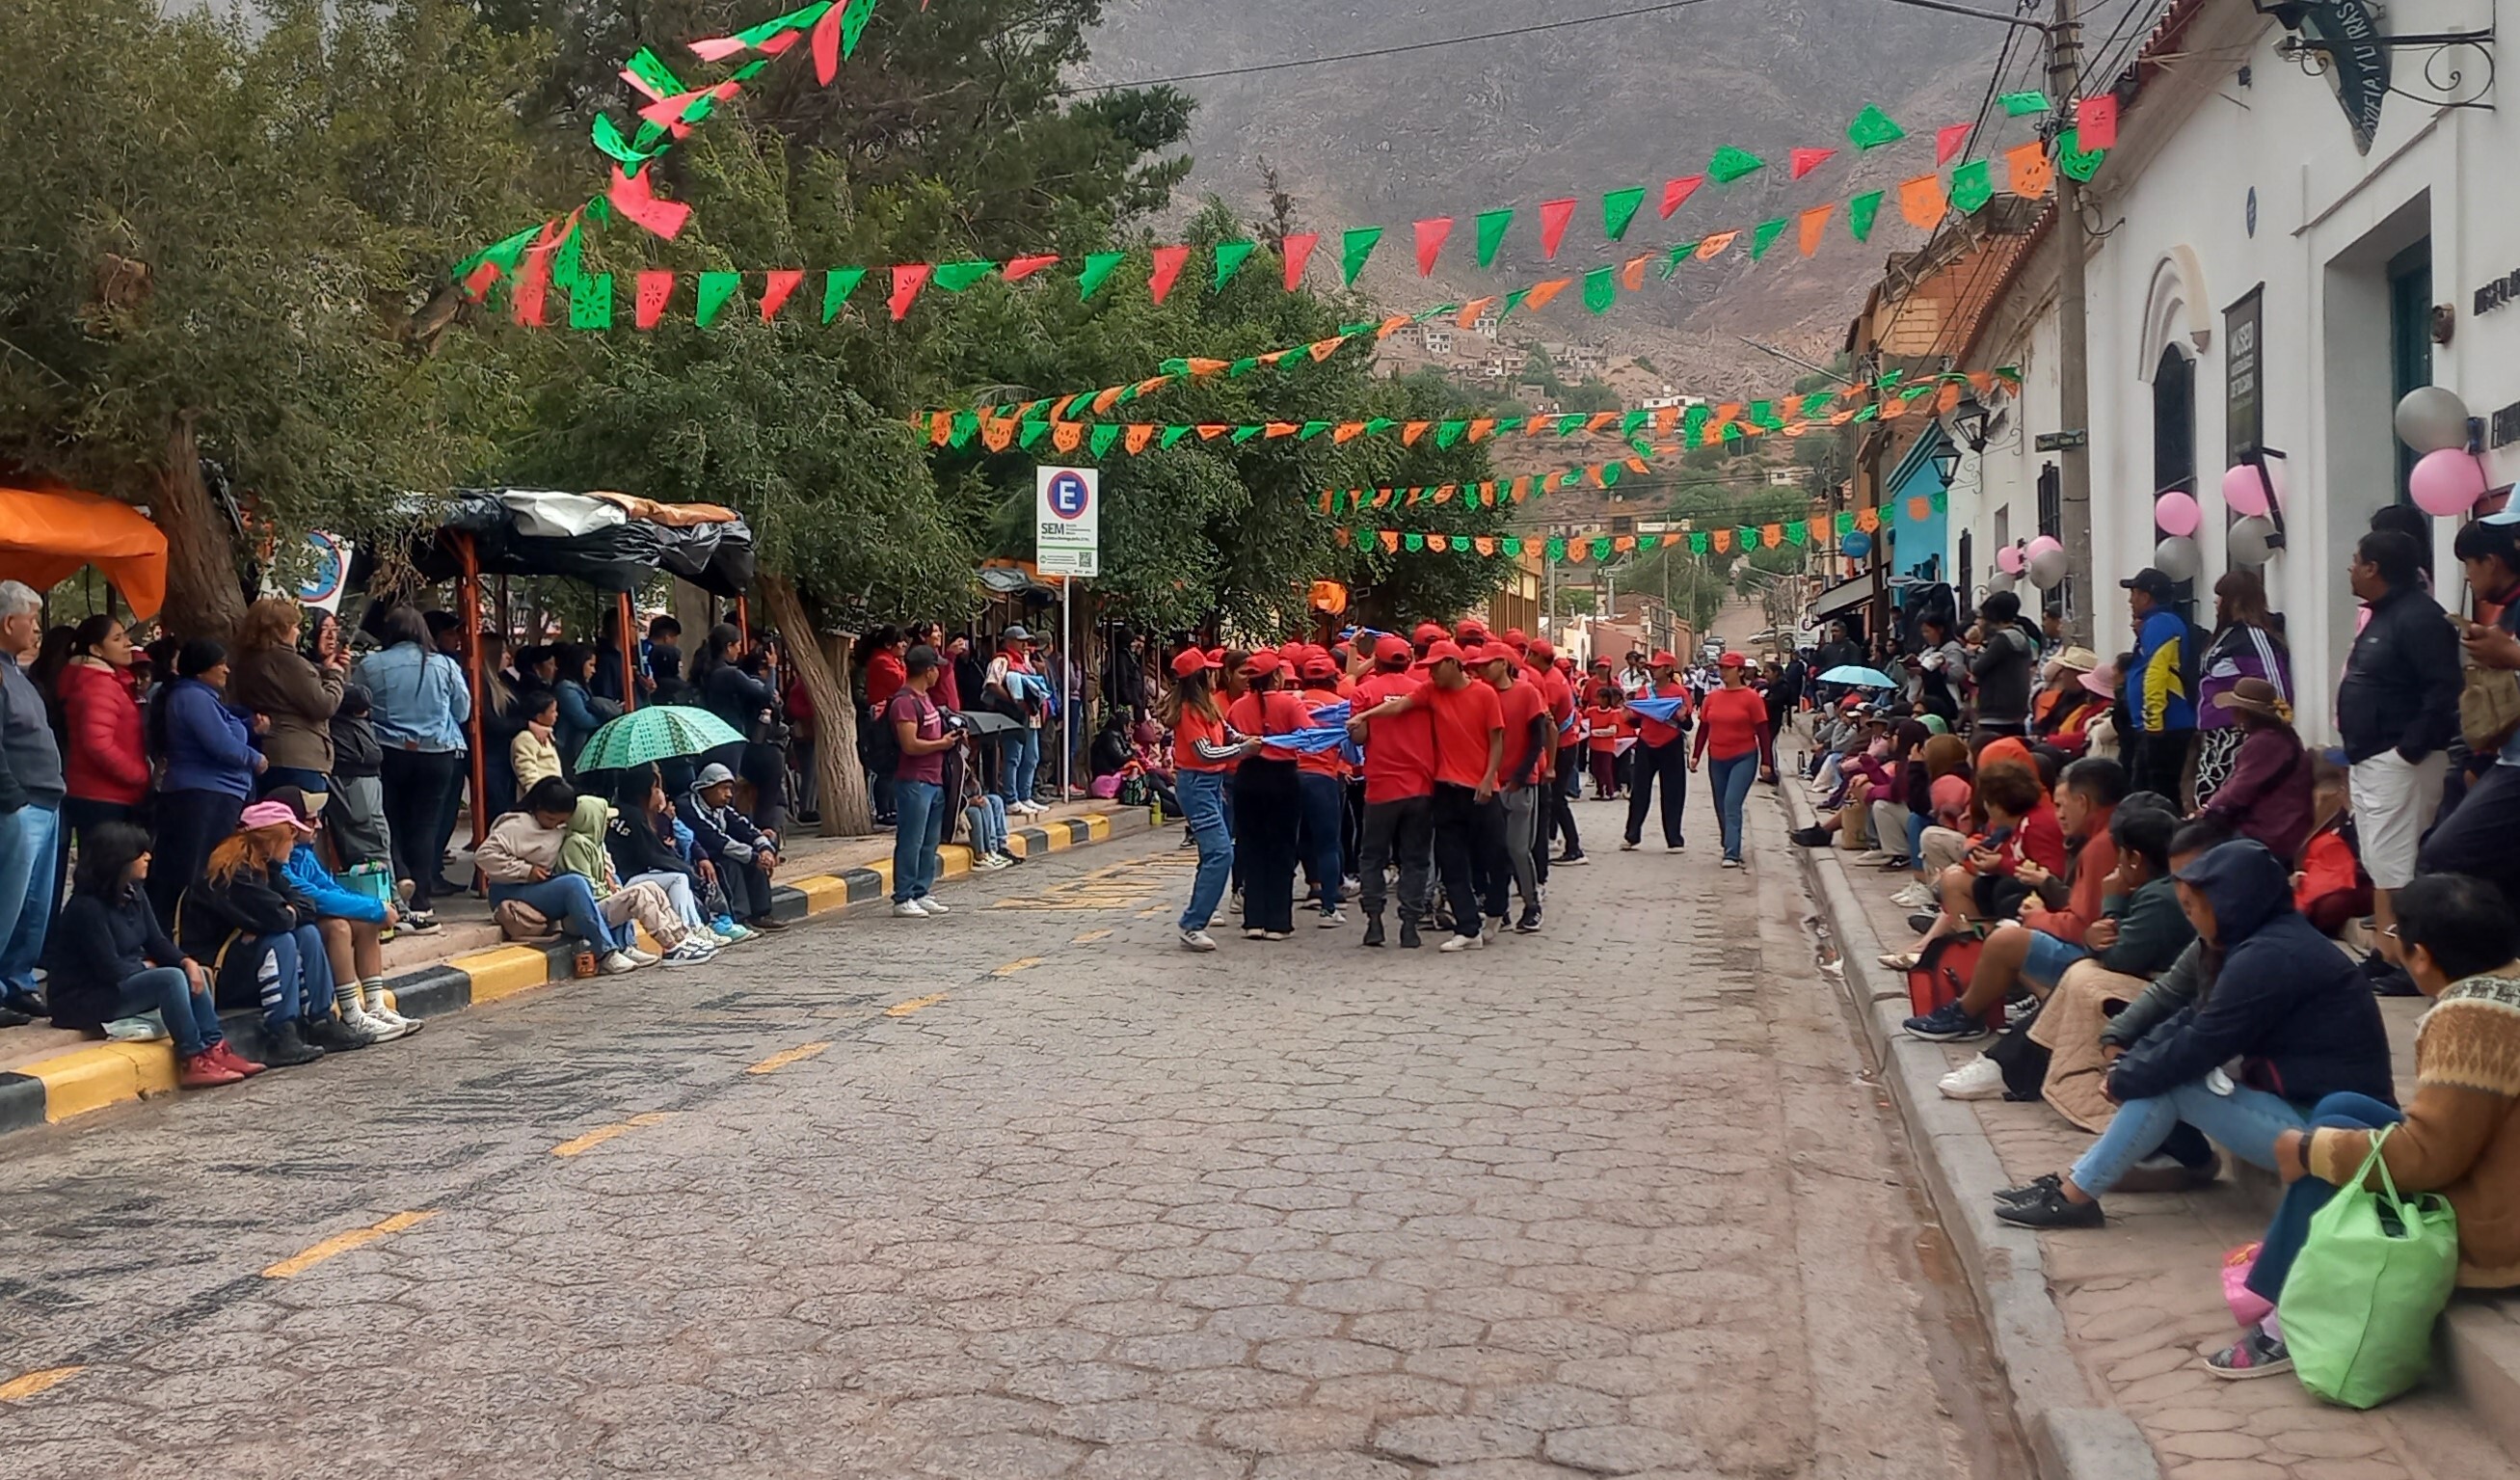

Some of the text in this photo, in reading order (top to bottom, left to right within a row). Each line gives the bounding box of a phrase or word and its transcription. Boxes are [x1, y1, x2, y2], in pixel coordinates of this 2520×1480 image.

[2358, 62, 2380, 72] Y
[1059, 480, 1077, 510] E
[1041, 523, 1064, 535] SEM
